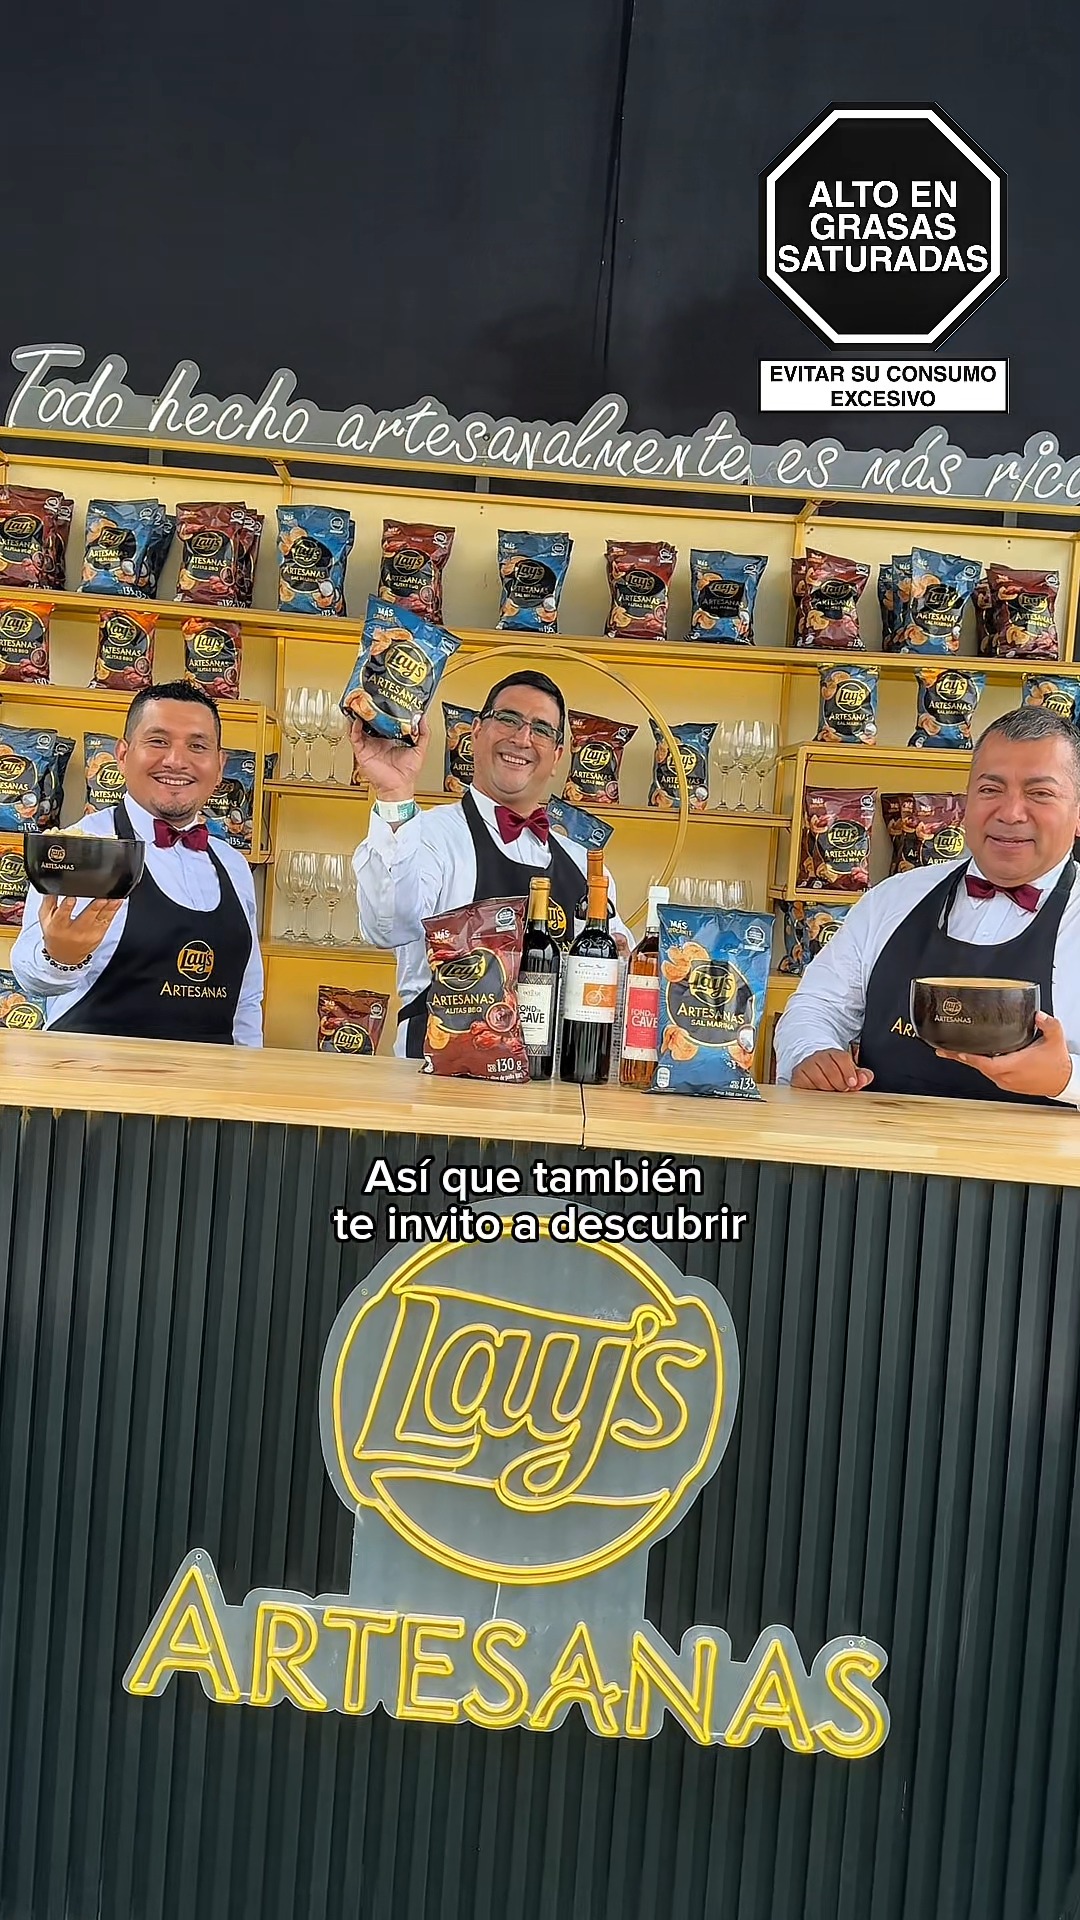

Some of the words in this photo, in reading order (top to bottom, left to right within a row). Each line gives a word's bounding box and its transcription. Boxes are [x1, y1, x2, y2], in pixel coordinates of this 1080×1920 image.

[8, 348, 124, 428] Todo
[148, 369, 308, 444] hecho
[336, 401, 751, 481] artesanalmente
[777, 447, 840, 487] es
[861, 436, 962, 495] más
[619, 594, 661, 605] ARTESANAS
[702, 599, 744, 608] ARTESANAS
[377, 606, 394, 617] MÁS
[189, 659, 230, 668] ARTESANAS
[387, 648, 425, 678] Lay's
[368, 674, 424, 710] ARTESANAS
[377, 688, 390, 698] SAL
[929, 700, 972, 711] ARTESANAS
[828, 711, 869, 720] ARTESANAS
[453, 762, 475, 771] ARTES
[572, 769, 613, 781] ARTESANAS
[207, 798, 238, 807] TESANAS
[825, 849, 866, 858] ARTESANAS
[670, 919, 688, 930] MÁS
[434, 928, 450, 940] MÁS
[180, 949, 213, 973] Lay's
[160, 980, 227, 998] ARTESANAS
[692, 970, 733, 998] Lay's
[432, 993, 496, 1007] ARTESANAS
[677, 1002, 745, 1025] ARTESANAS
[691, 1019, 706, 1027] SAL
[706, 1020, 735, 1031] MARINA
[496, 1057, 514, 1072] 130
[516, 1060, 522, 1070] g
[354, 1292, 707, 1512] Lay's
[129, 1564, 889, 1759] ARTESANAS
